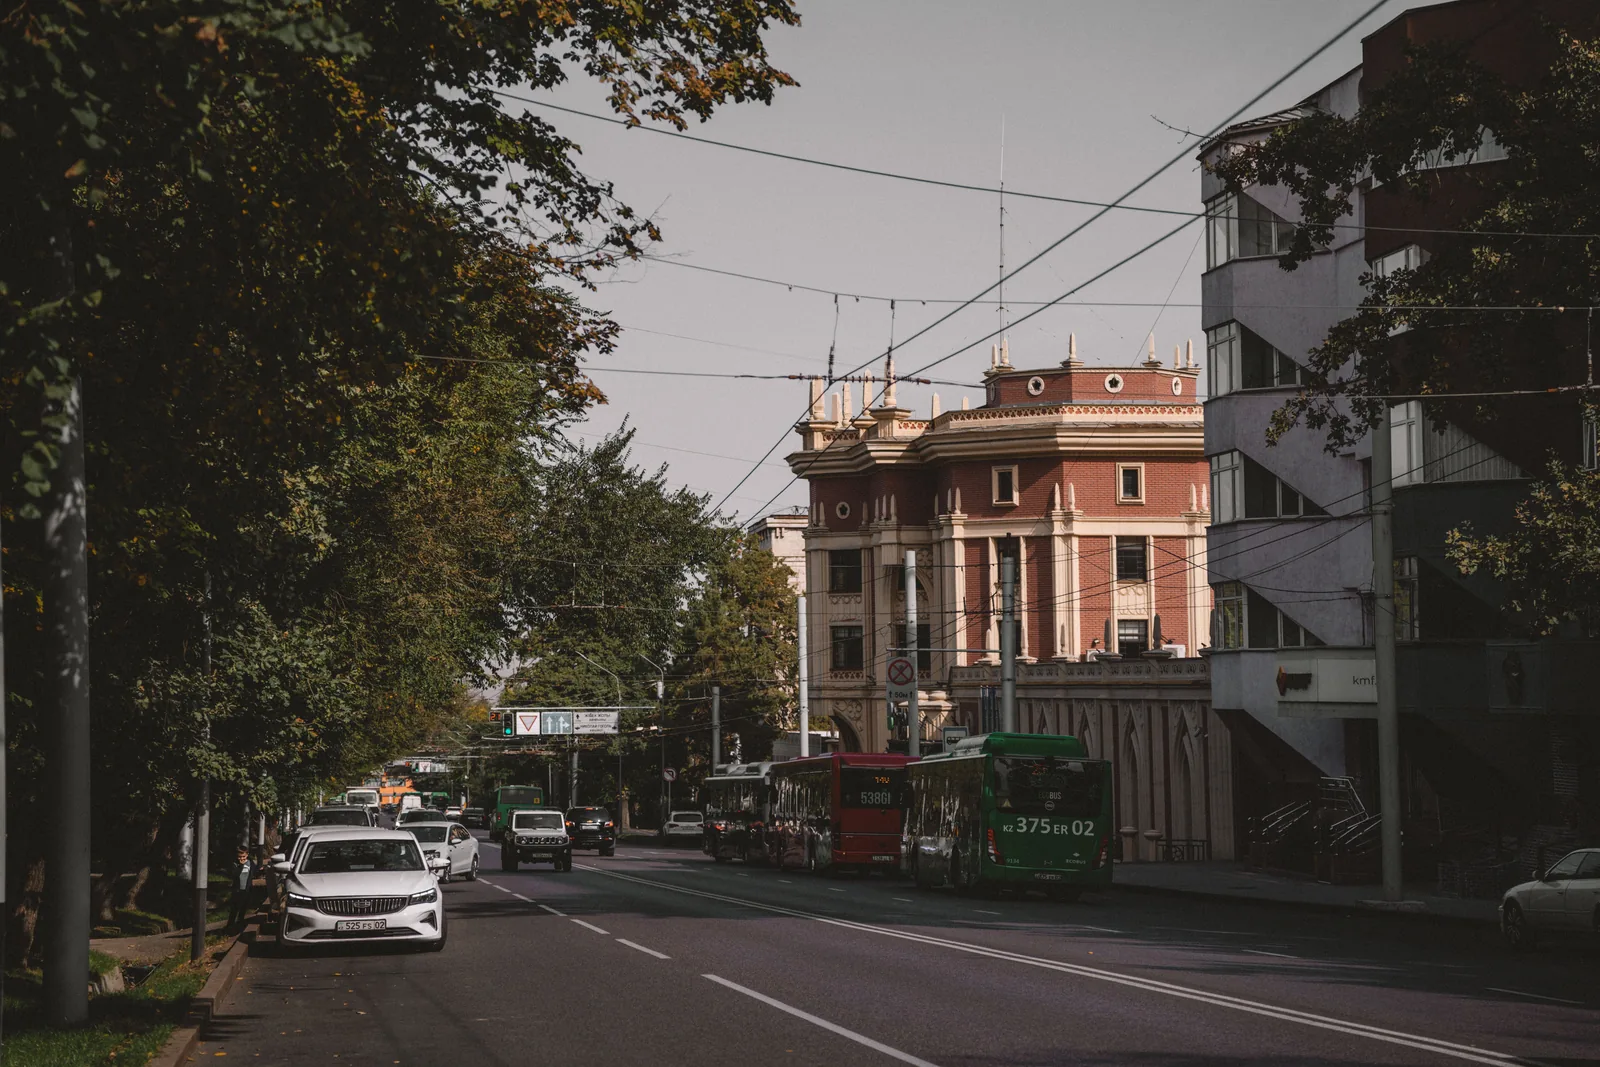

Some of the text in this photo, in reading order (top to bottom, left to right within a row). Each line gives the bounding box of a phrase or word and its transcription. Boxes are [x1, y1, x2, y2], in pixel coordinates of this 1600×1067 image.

[1003, 816, 1095, 837] KZ 375 ER 02
[345, 921, 360, 930] 525
[374, 921, 385, 929] 02
